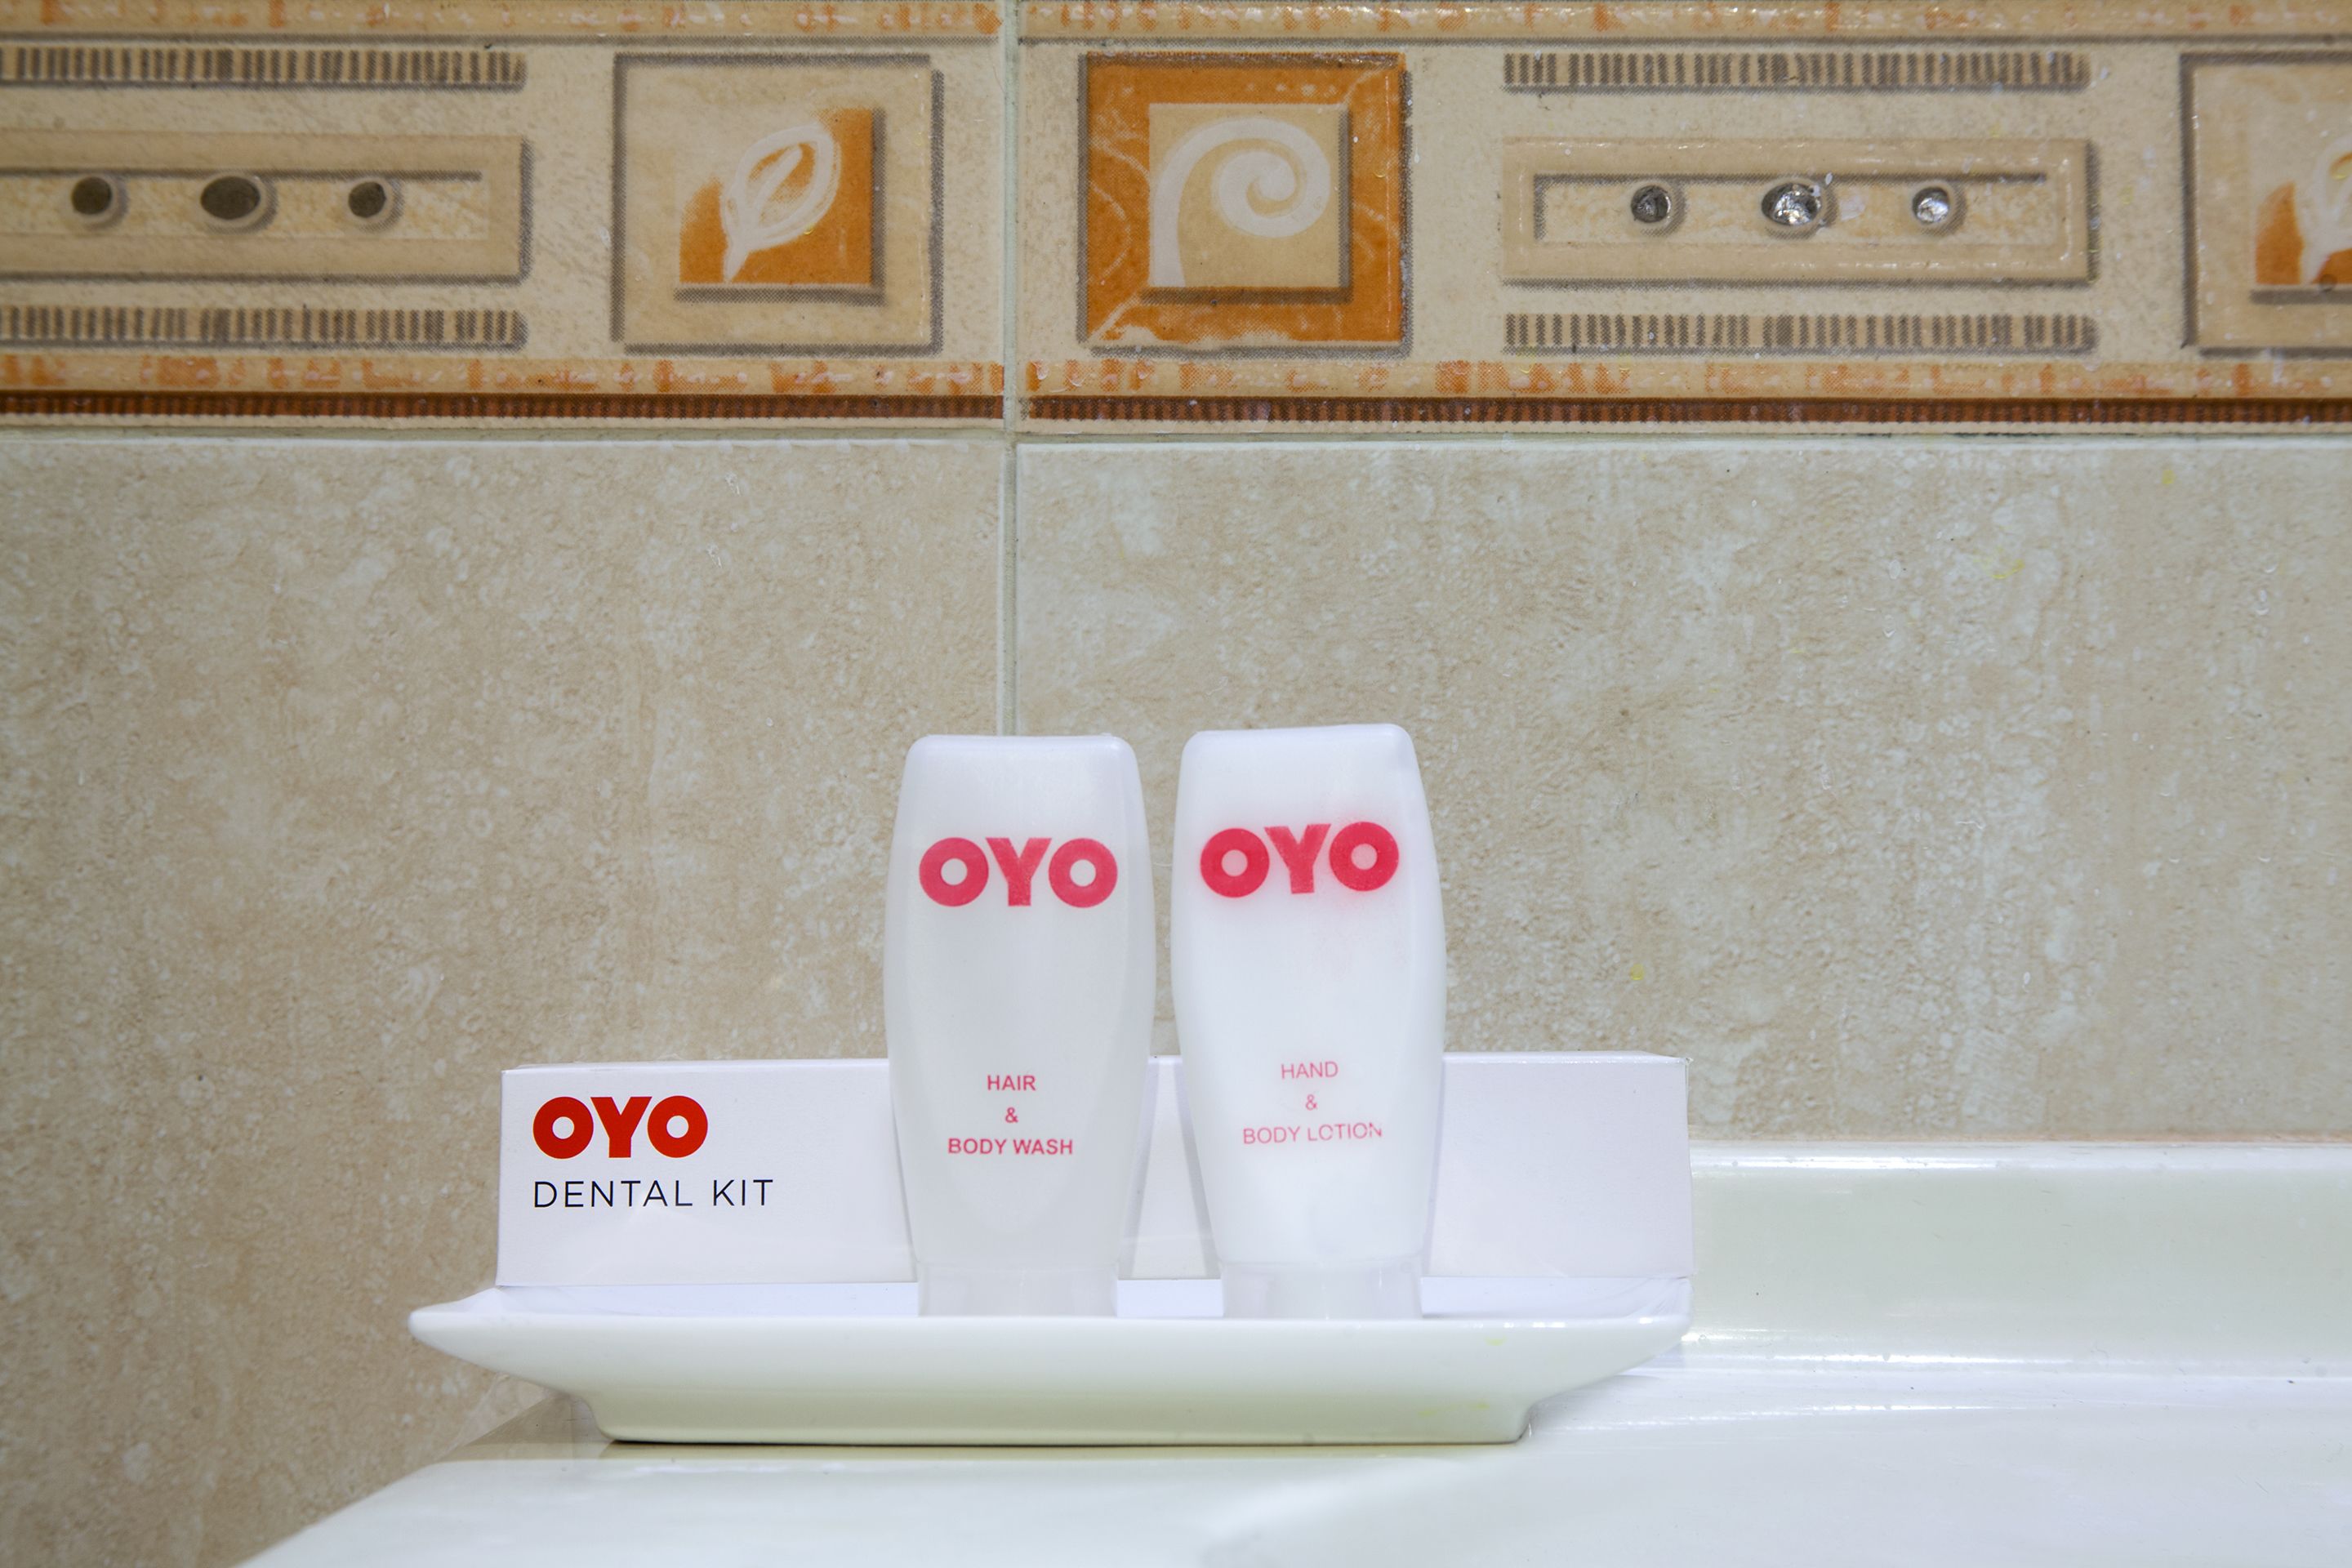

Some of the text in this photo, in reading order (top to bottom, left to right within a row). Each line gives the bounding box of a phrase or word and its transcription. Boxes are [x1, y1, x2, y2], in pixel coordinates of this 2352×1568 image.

[1199, 821, 1400, 897] OYO
[920, 837, 1118, 908] OYO
[1280, 1061, 1339, 1080] HAND
[987, 1075, 1037, 1092] HAIR
[1305, 1094, 1318, 1111] &
[1004, 1106, 1020, 1125] &
[533, 1095, 708, 1159] OYO
[1242, 1121, 1383, 1145] BODY LOTION
[947, 1137, 1074, 1156] BODY WASH
[534, 1178, 773, 1208] DENTAL KIT
